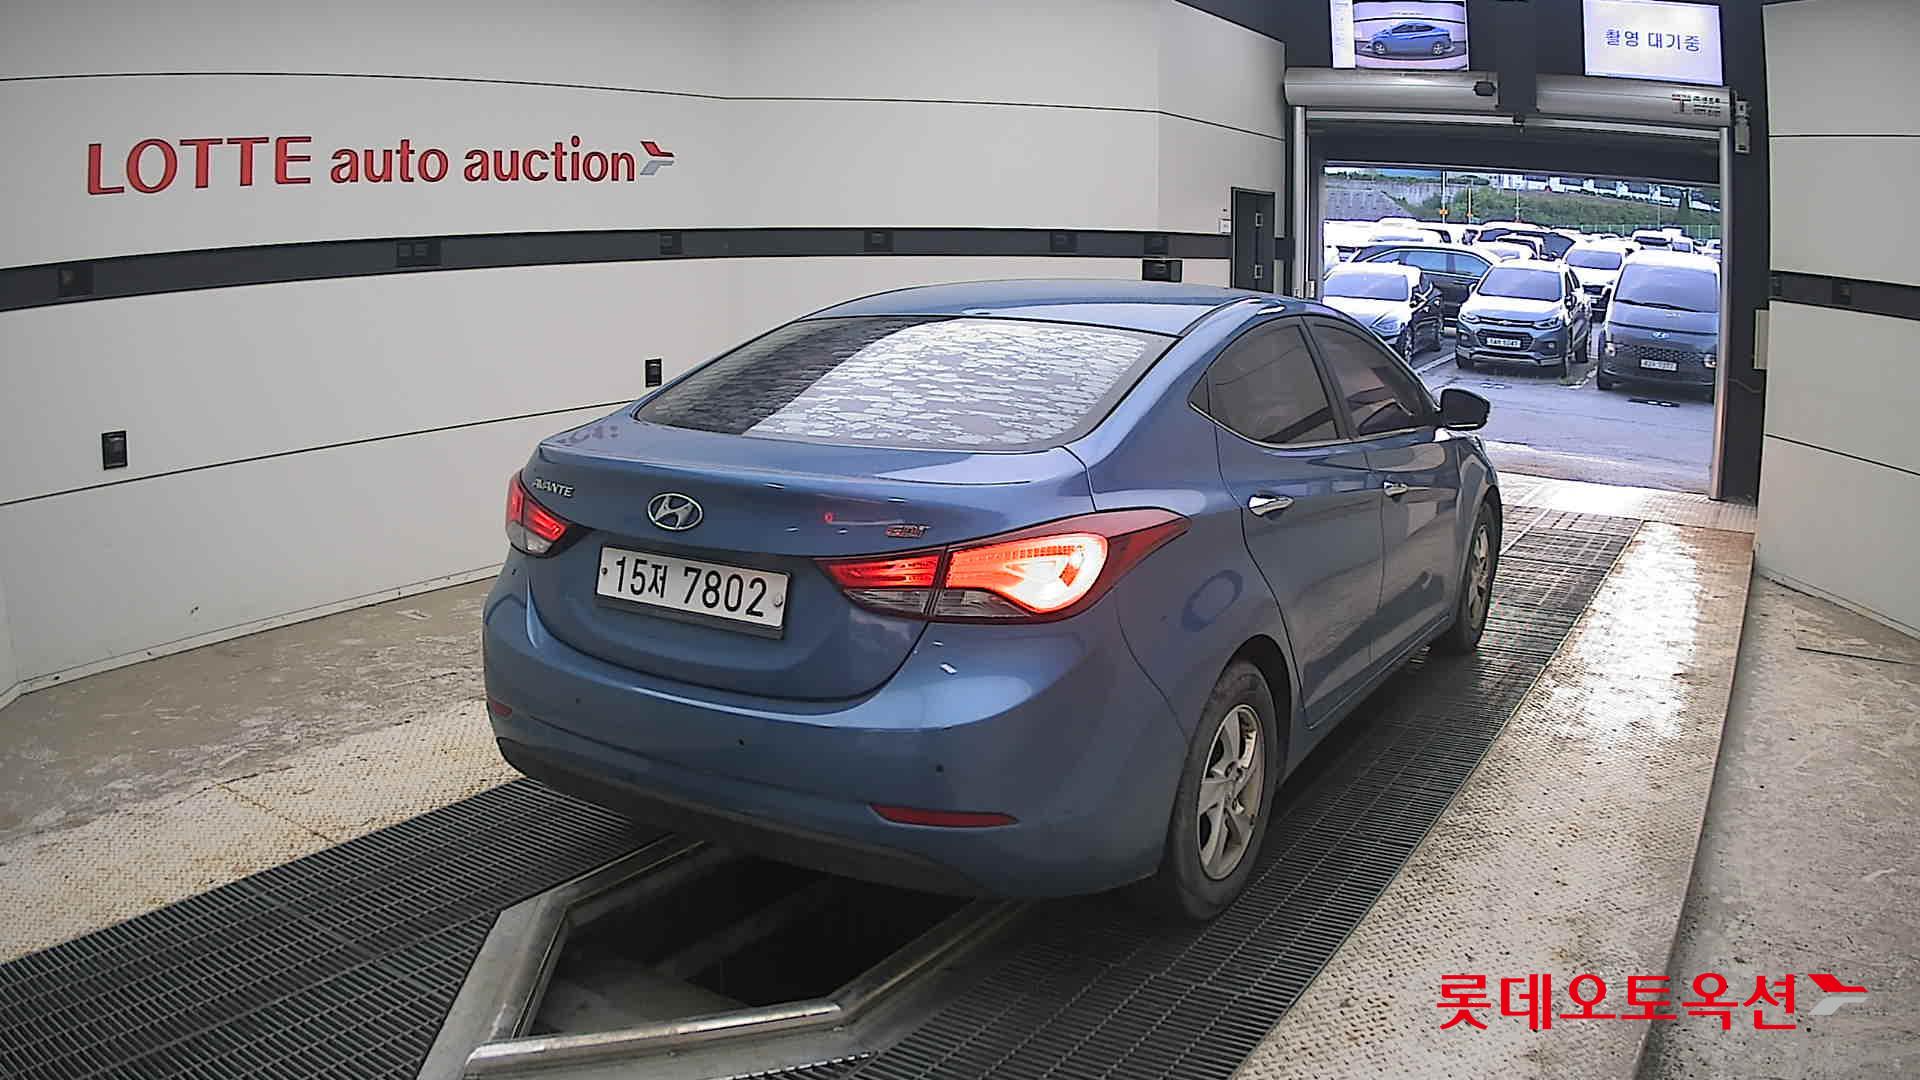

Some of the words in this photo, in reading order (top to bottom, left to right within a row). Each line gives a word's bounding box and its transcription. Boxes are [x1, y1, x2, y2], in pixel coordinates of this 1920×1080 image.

[1604, 28, 1640, 48] 촬영
[1647, 31, 1702, 53] 대기중
[86, 135, 312, 195] LOTTE
[330, 138, 449, 184] auto
[463, 135, 636, 182] auction
[531, 478, 575, 498] AVANTE
[615, 555, 667, 599] 15저
[682, 565, 768, 619] 7802
